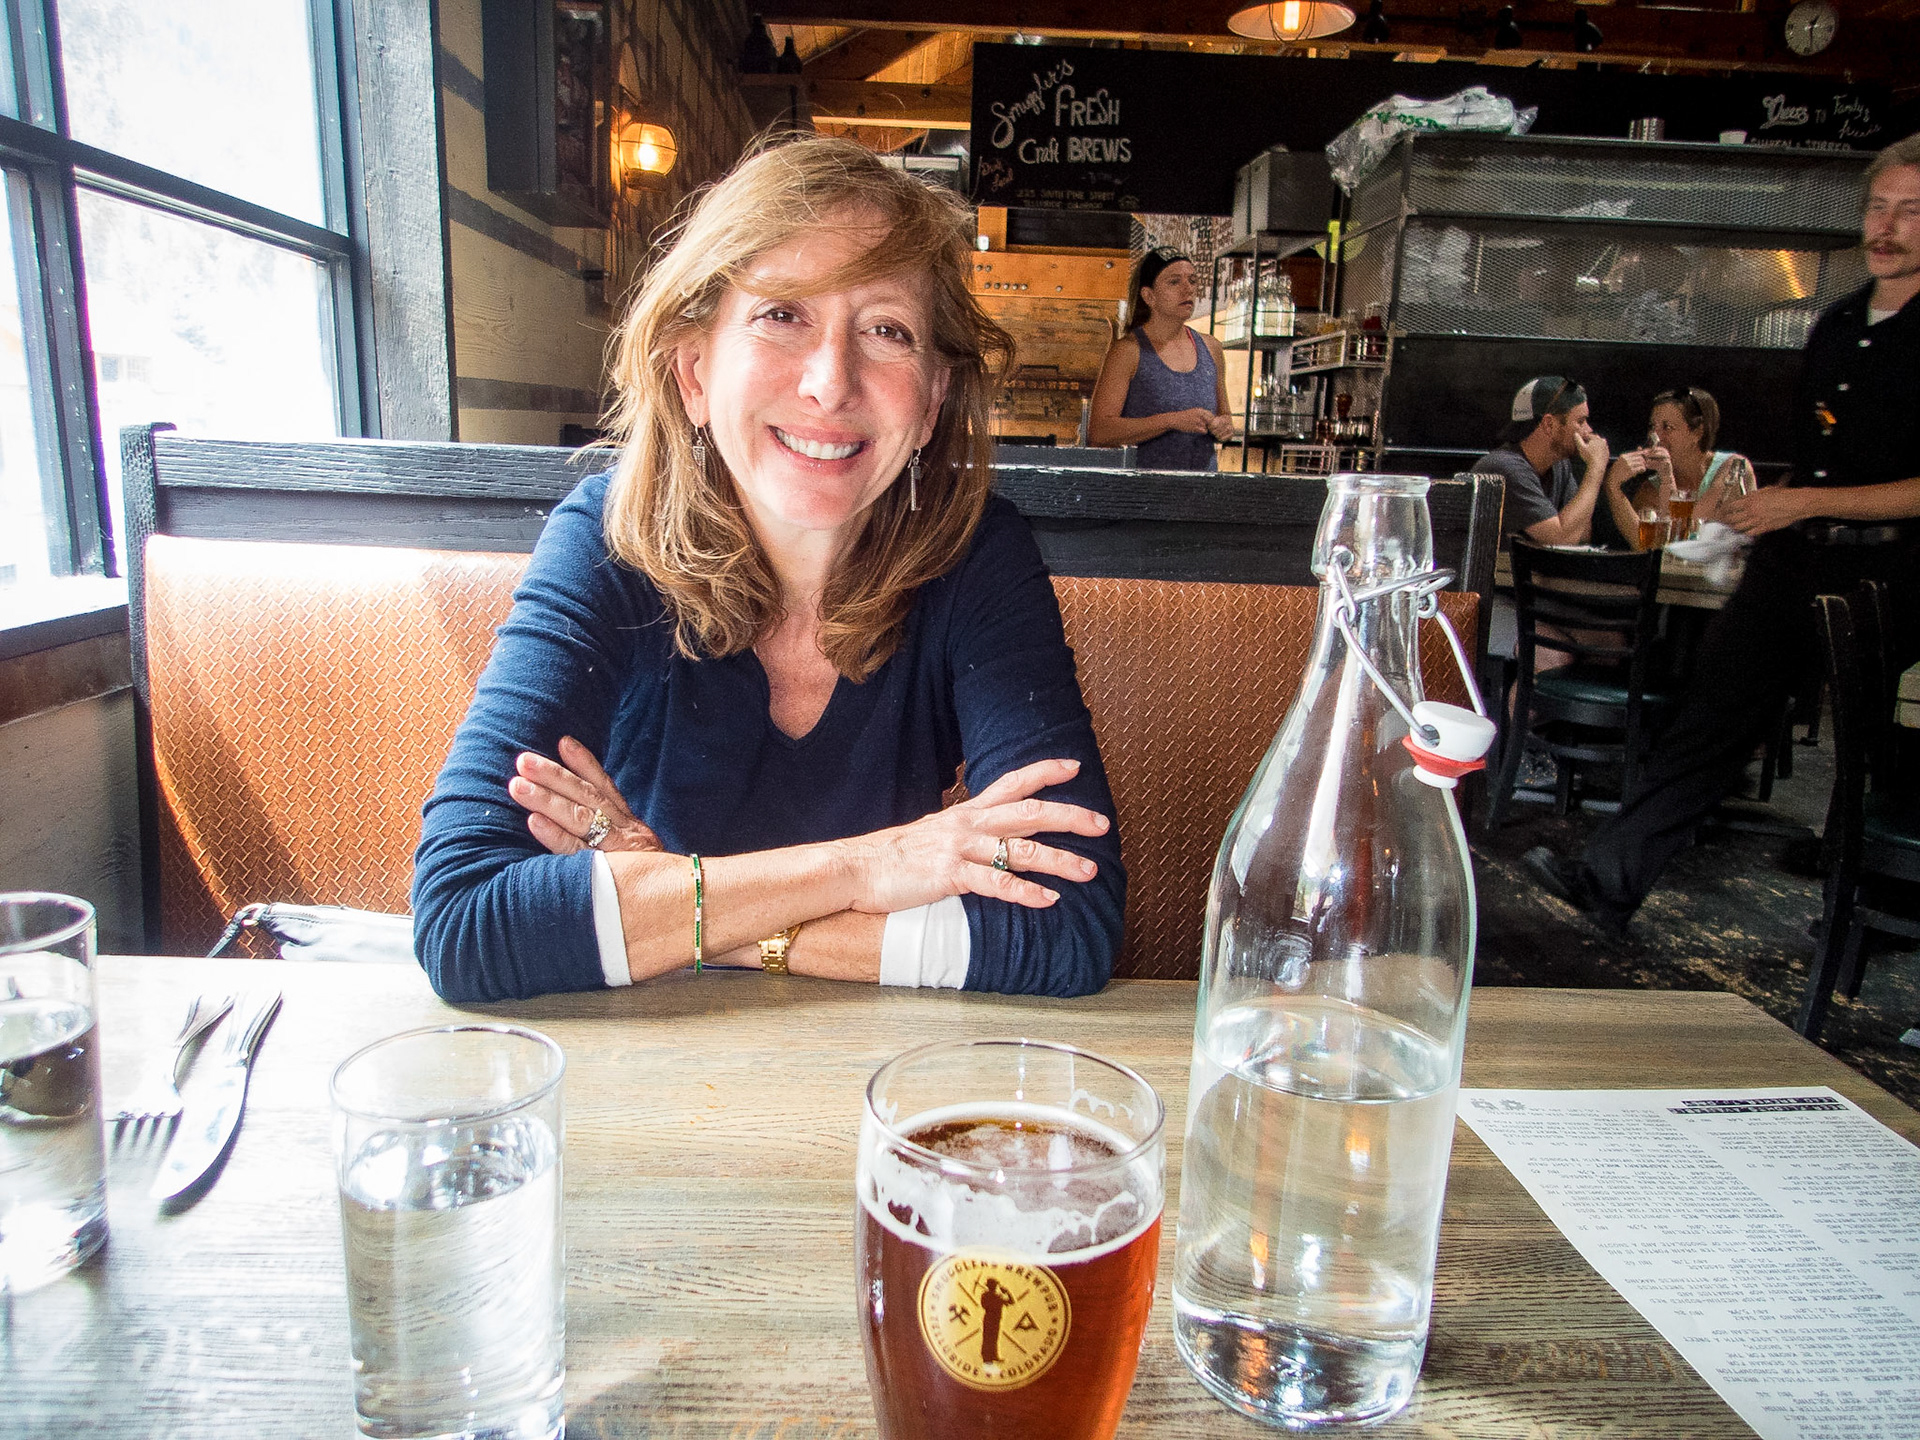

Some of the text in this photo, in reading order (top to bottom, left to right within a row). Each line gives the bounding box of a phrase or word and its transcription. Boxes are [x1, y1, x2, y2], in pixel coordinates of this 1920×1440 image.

[1055, 84, 1120, 126] FRESH
[1019, 137, 1133, 164] Craft BREWS
